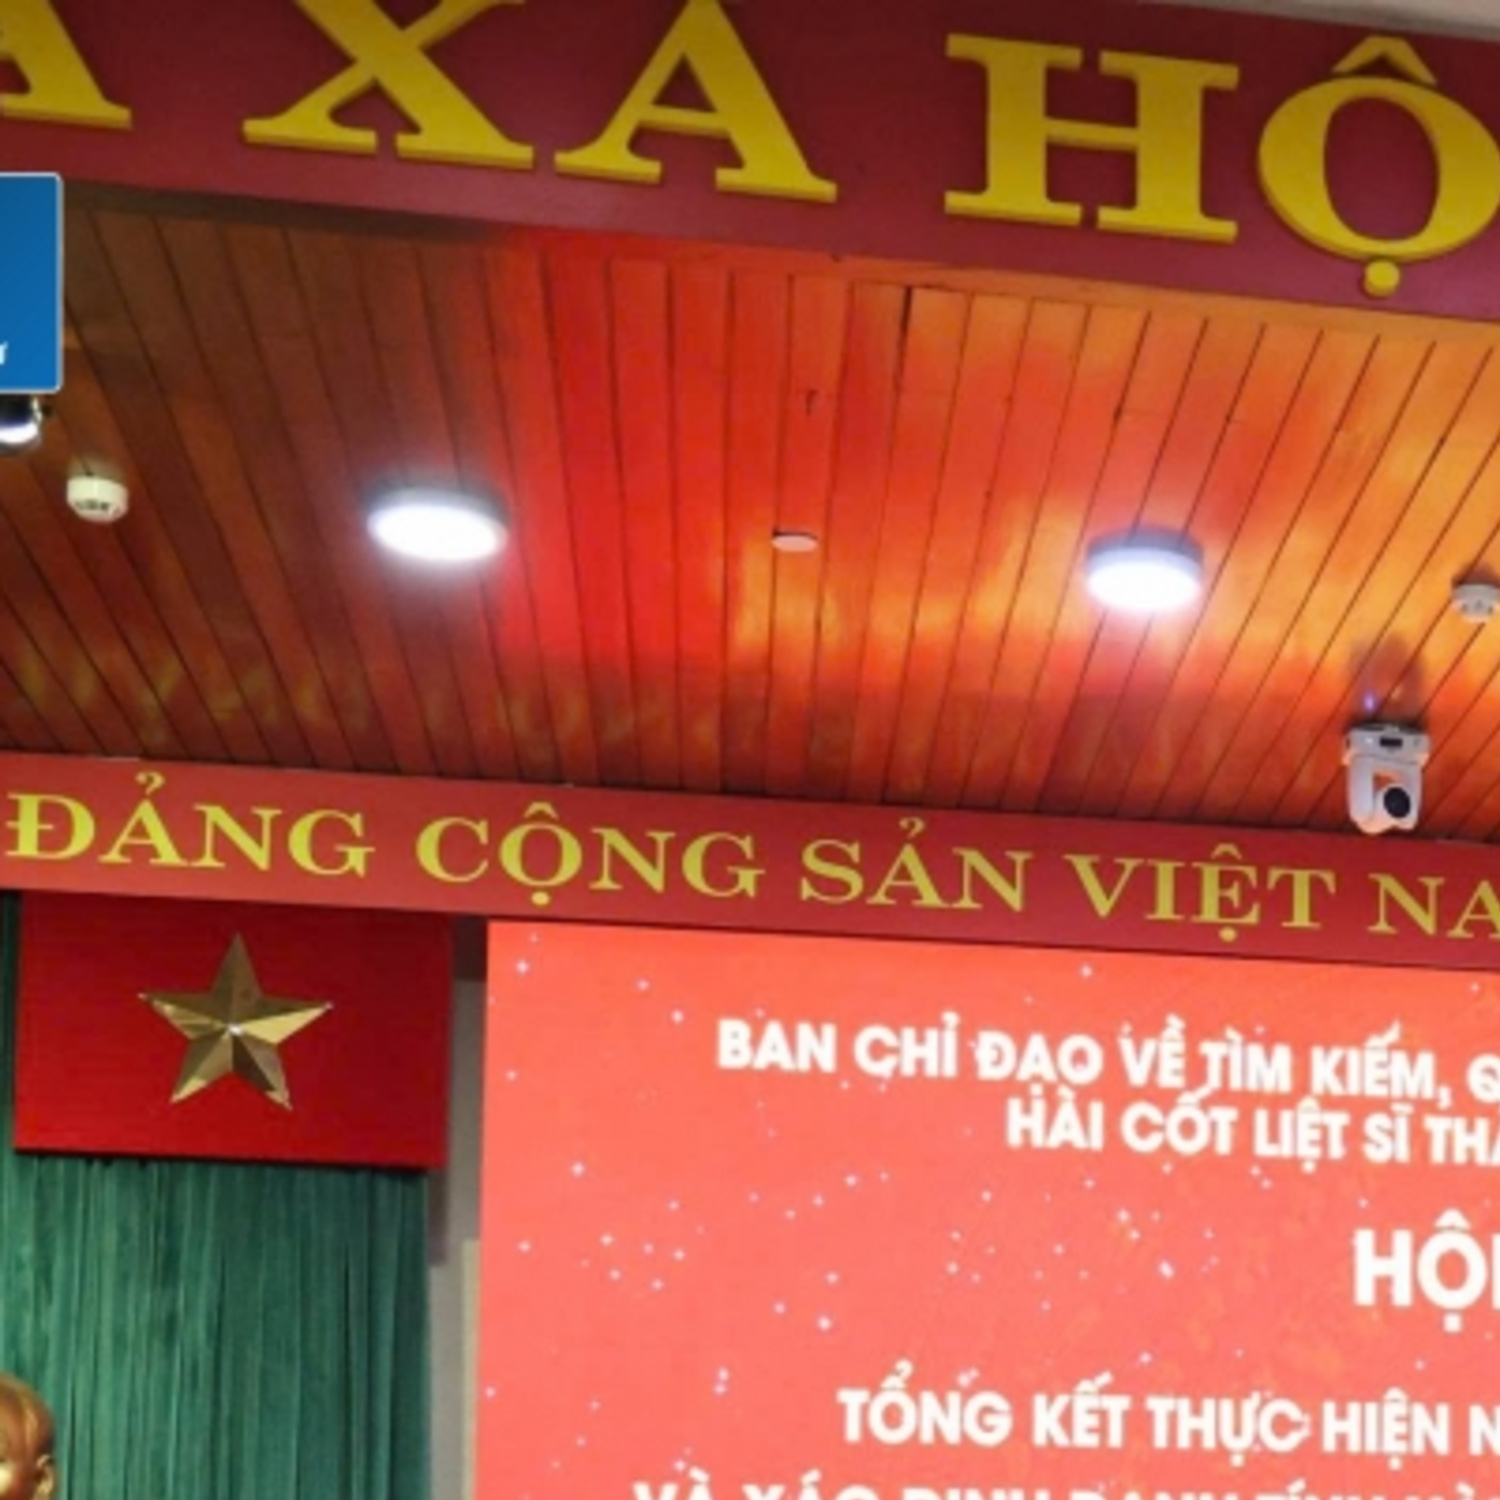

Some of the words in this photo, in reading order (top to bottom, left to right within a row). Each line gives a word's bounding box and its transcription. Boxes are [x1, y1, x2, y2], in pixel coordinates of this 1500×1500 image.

[5, 771, 376, 878] ĐẢNG
[414, 802, 765, 908] CỘNG
[799, 816, 1030, 912] SẢN
[1064, 842, 1336, 942] VIỆT
[717, 1019, 837, 1073] BAN
[853, 1010, 959, 1078] CHỈ
[974, 1031, 1104, 1093] ĐẠO
[1118, 1014, 1187, 1089] VỀ
[1198, 1029, 1293, 1094] TÌM
[1310, 1022, 1452, 1107] KIẾM,
[1005, 1085, 1104, 1151] HÀI
[1120, 1079, 1240, 1156] CỐT
[1253, 1096, 1350, 1174] LIỆT
[1362, 1101, 1413, 1163] SĨ
[836, 1359, 1014, 1447] TỔNG
[1031, 1370, 1132, 1449] KẾT
[1145, 1393, 1312, 1467] THỰC
[1320, 1386, 1452, 1471] HIỆN
